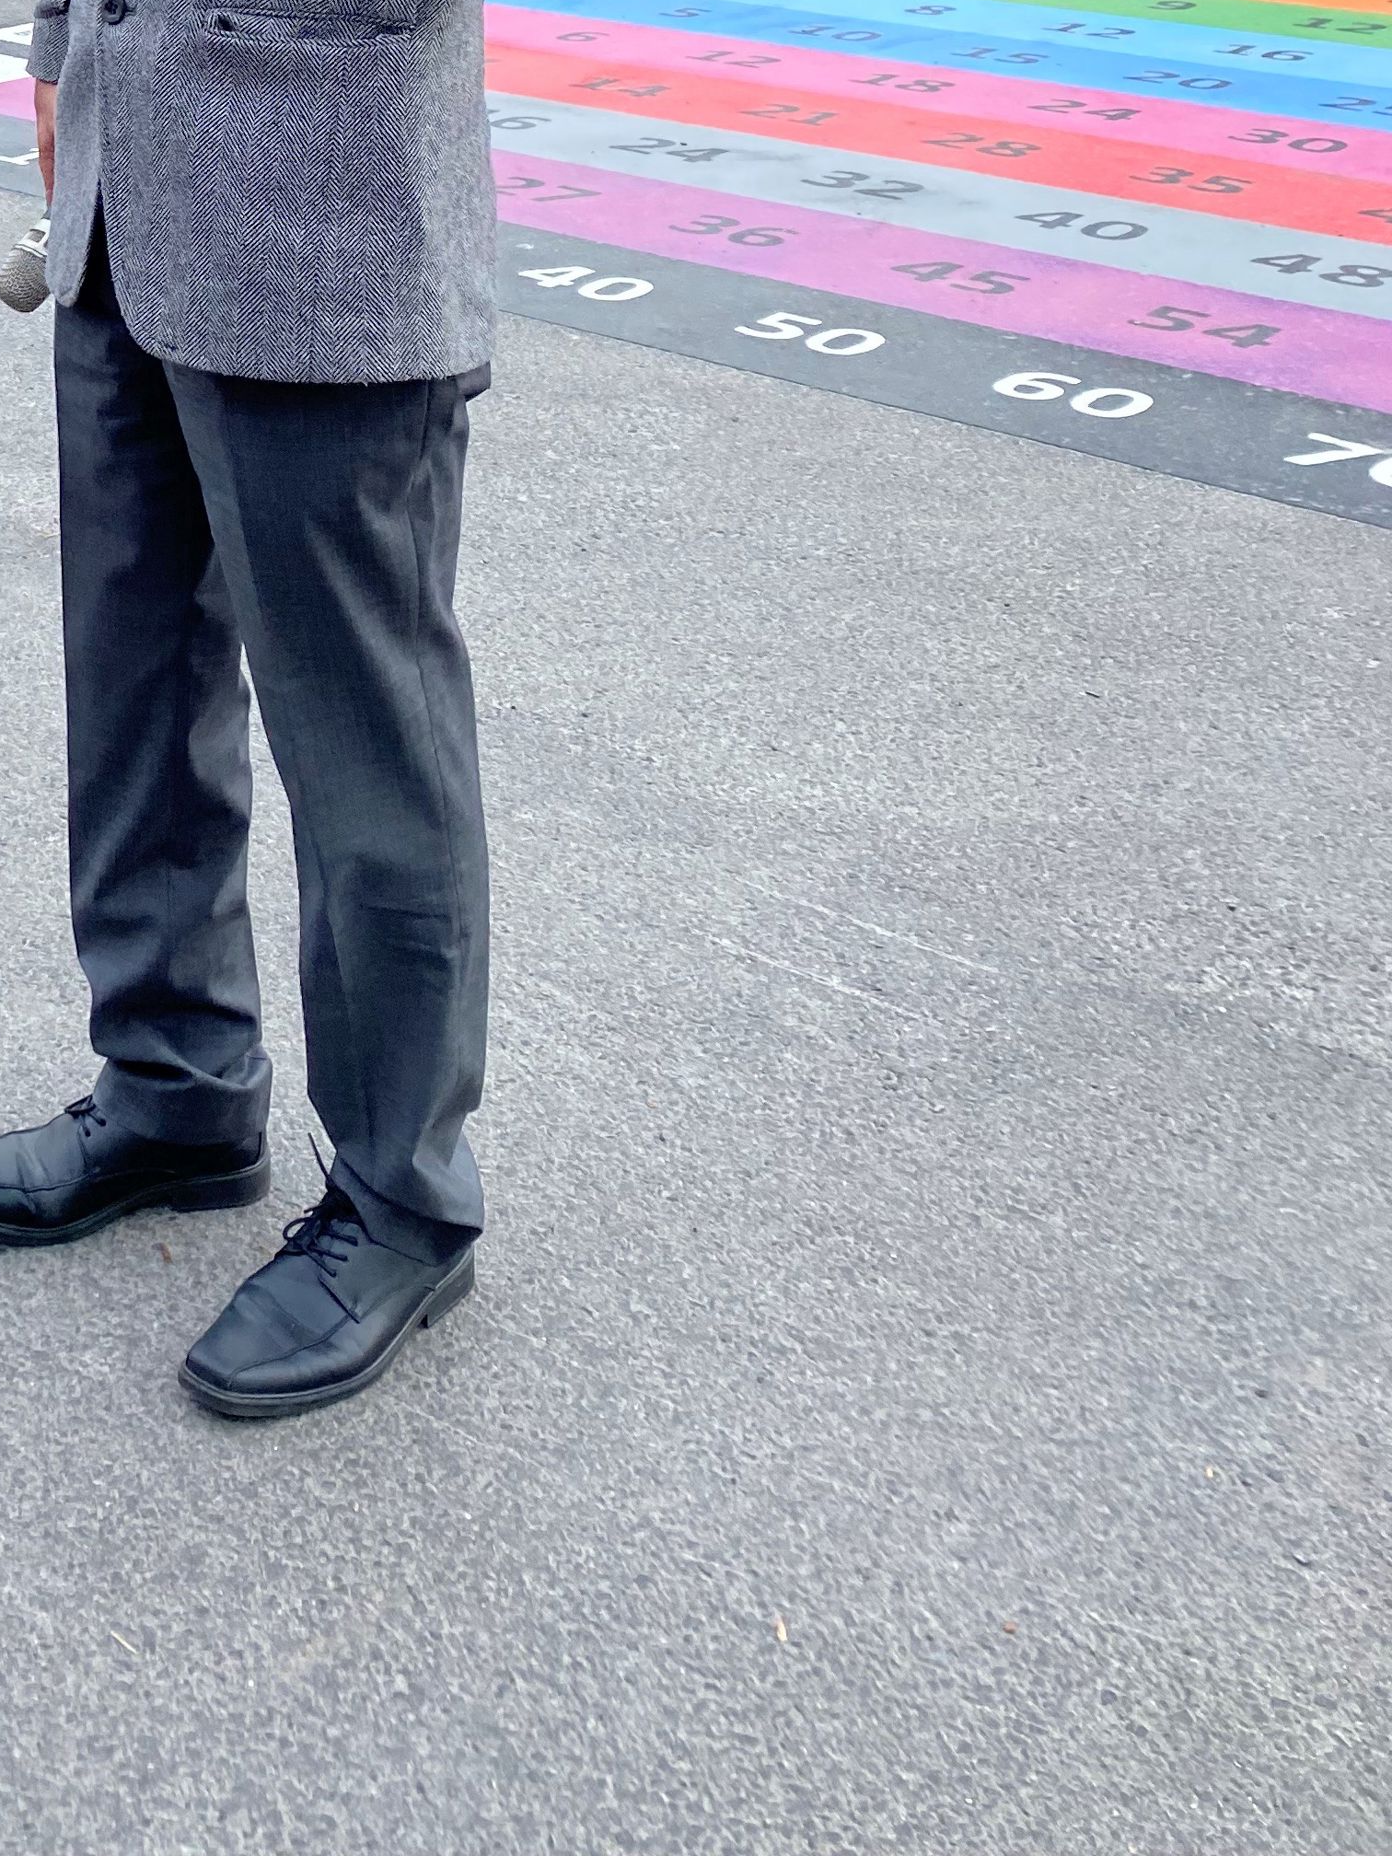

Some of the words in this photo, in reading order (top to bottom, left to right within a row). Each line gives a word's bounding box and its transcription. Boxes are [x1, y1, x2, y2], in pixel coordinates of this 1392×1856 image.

[659, 7, 712, 18] 5
[788, 25, 883, 42] 10
[952, 47, 1049, 64] 15
[1123, 70, 1233, 90] 20
[906, 5, 957, 15] 8
[1041, 23, 1136, 39] 12
[1213, 44, 1315, 61] 16
[1147, 0, 1196, 10] 9
[1292, 17, 1387, 35] 12
[556, 31, 610, 42] 6
[685, 50, 782, 69] 12
[849, 73, 956, 93] 18
[1027, 99, 1141, 122] 24
[1227, 128, 1348, 153] 30
[570, 77, 671, 97] 14
[738, 103, 840, 126] 21
[923, 132, 1042, 158] 28
[1129, 166, 1253, 194] 35
[488, 109, 552, 130] 6
[608, 137, 732, 162] 24
[800, 170, 925, 200] 32
[1015, 211, 1149, 241] 40
[1250, 254, 1392, 287] 48
[496, 176, 603, 202] 27
[669, 215, 800, 247] 36
[890, 261, 1030, 295] 45
[1127, 305, 1283, 349] 54
[518, 265, 655, 302] 40
[734, 311, 887, 356] 50
[991, 371, 1155, 419] 60
